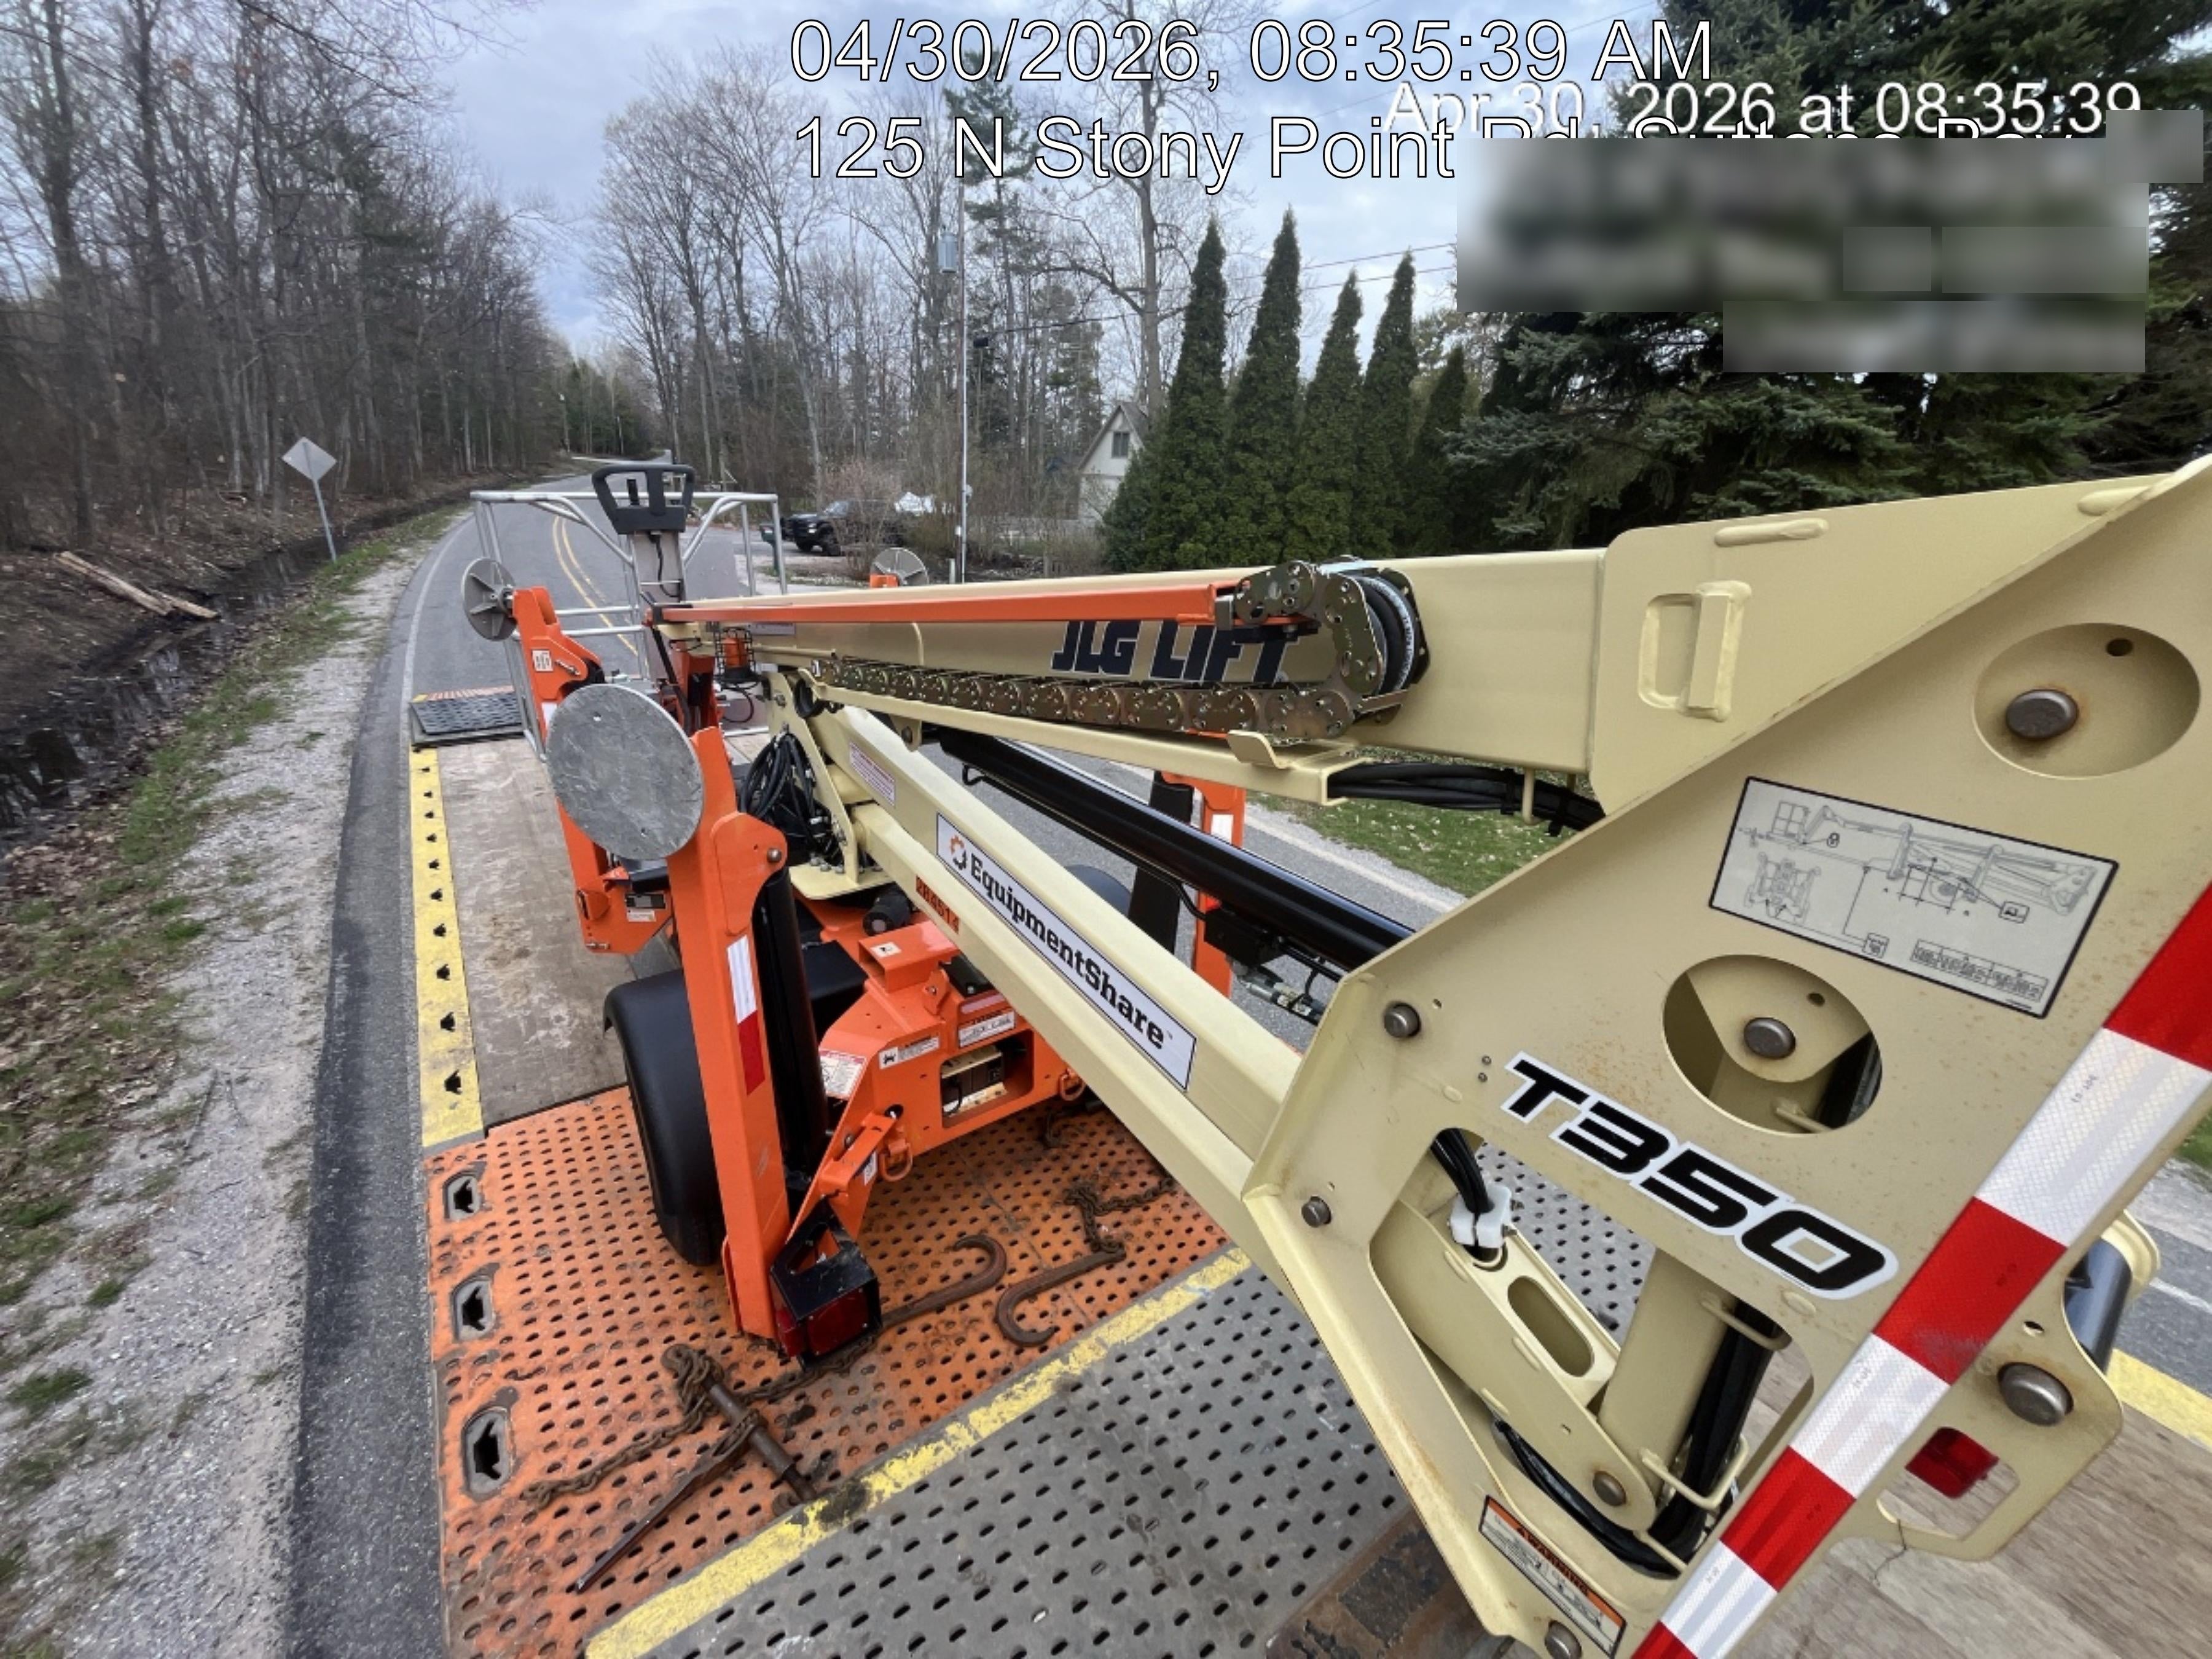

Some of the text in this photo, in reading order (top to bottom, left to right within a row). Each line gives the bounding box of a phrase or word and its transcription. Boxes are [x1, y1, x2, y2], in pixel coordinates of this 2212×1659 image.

[1051, 619, 1142, 675] JLG
[971, 852, 1164, 1049] EquipmentShare
[1505, 1055, 1891, 1295] T350
